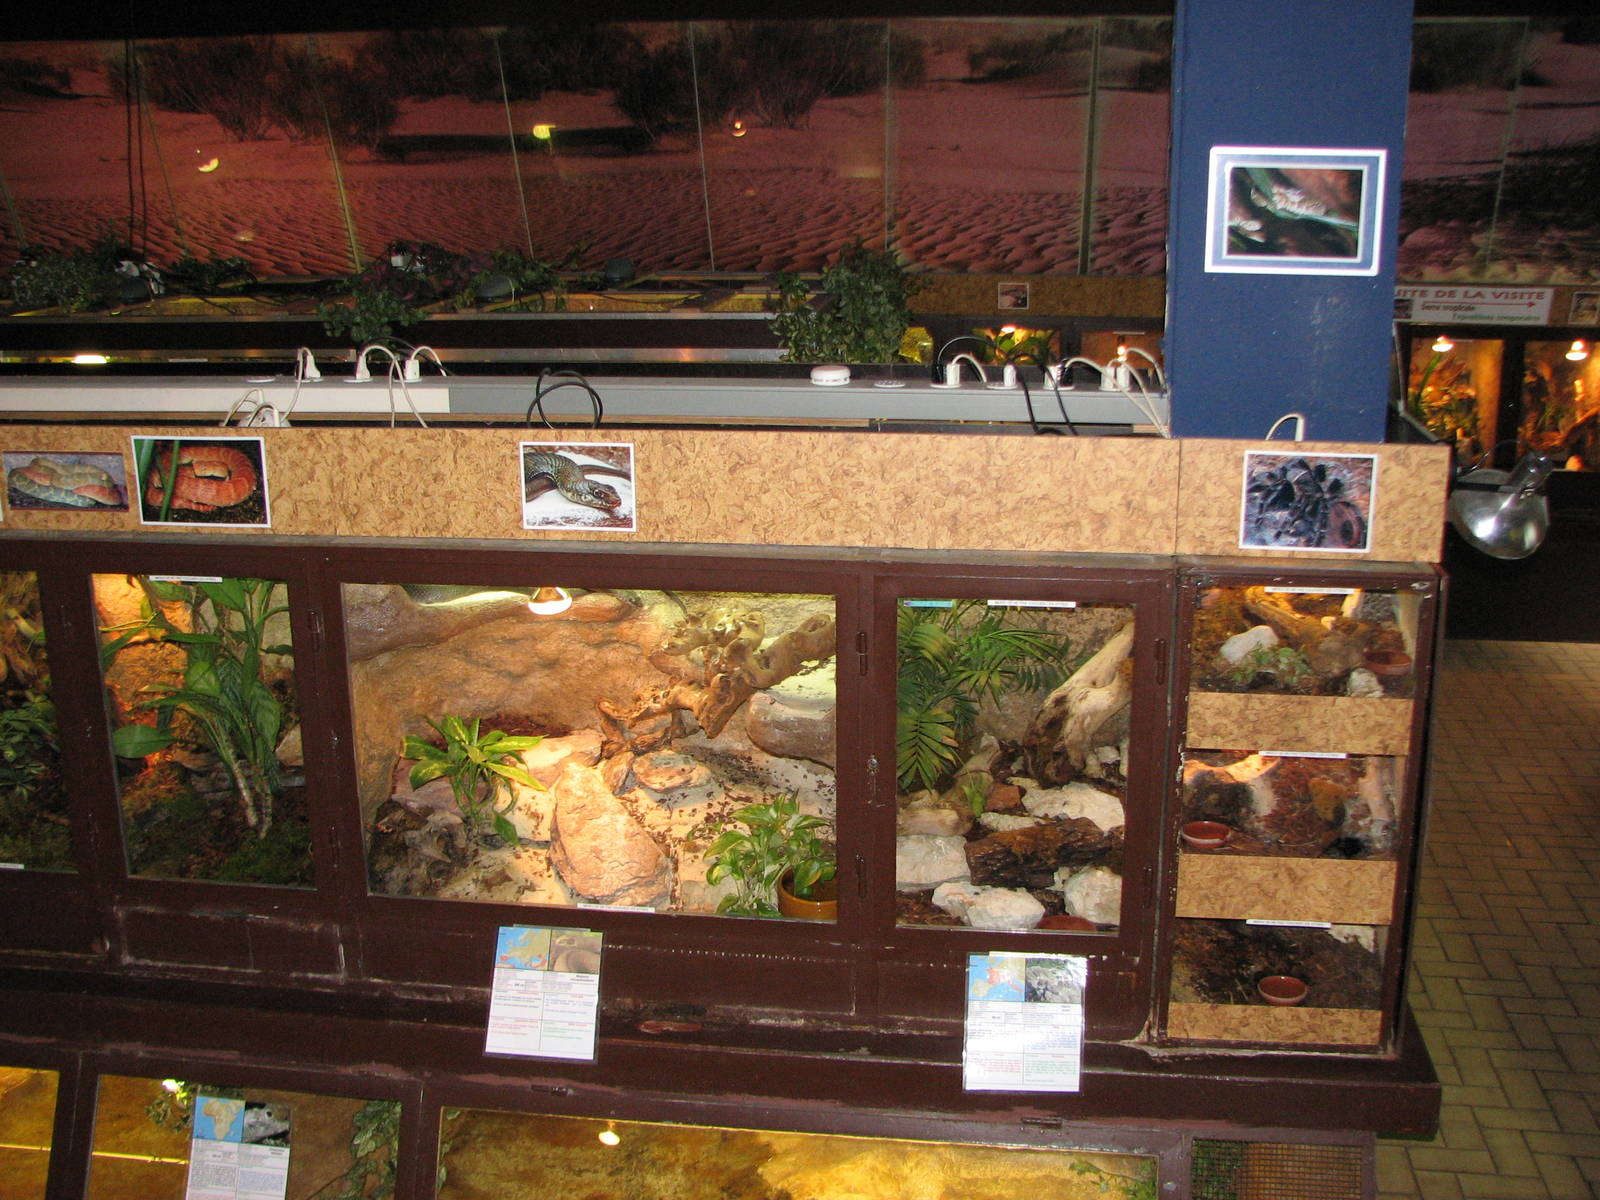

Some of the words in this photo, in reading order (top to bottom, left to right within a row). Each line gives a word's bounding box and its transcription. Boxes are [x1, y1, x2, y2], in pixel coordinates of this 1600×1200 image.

[1434, 290, 1456, 298] DE
[1463, 290, 1486, 299] LA
[1490, 291, 1545, 300] VISITE
